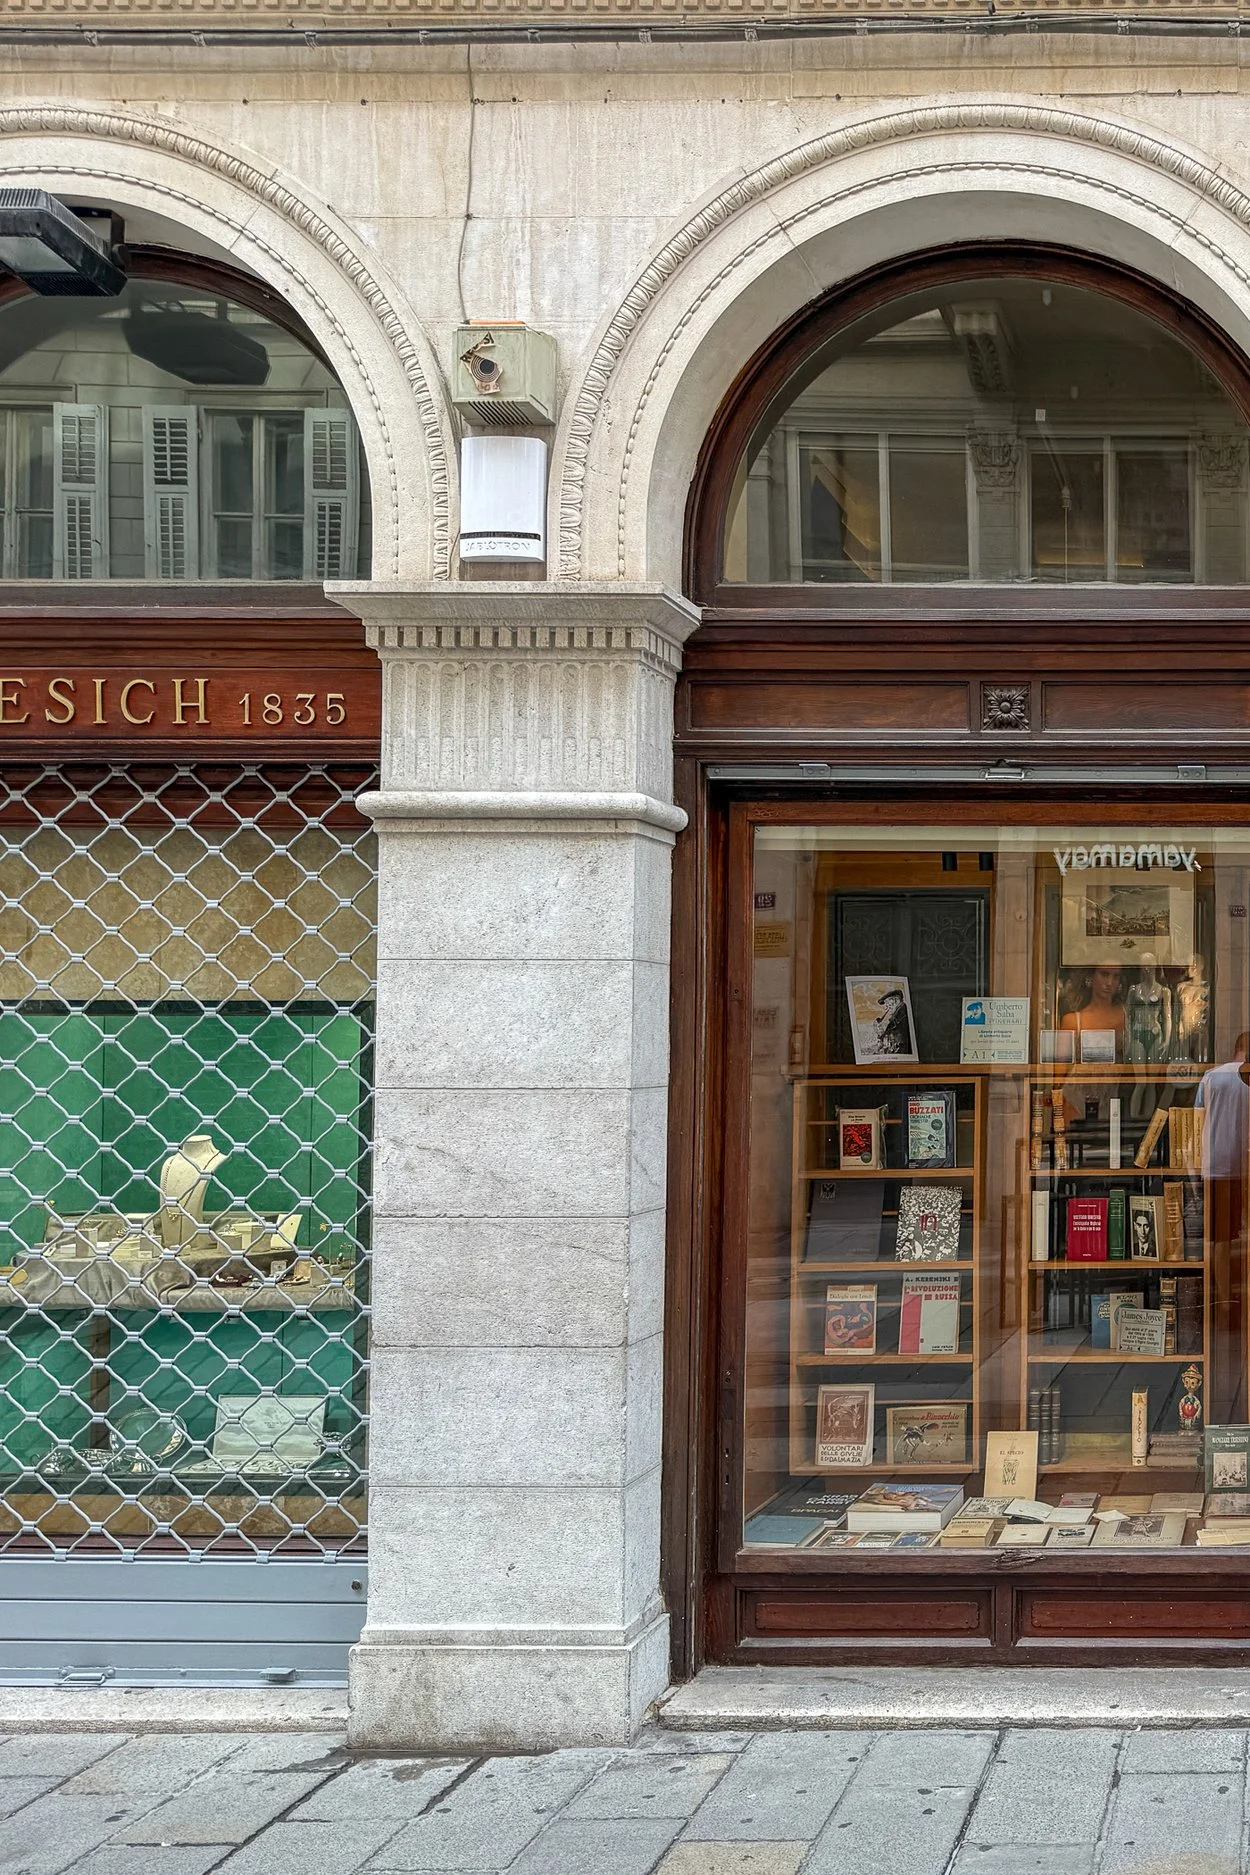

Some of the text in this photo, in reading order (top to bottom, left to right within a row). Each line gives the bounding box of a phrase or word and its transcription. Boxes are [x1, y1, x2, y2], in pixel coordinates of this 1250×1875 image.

[239, 693, 346, 724] 1835
[989, 1002, 1022, 1011] Umberto
[997, 1010, 1014, 1018] Saba
[909, 1106, 944, 1114] BUZZATI
[1121, 1311, 1142, 1320] James
[1143, 1312, 1162, 1322] Joyce
[926, 1412, 960, 1420] Pinocchio
